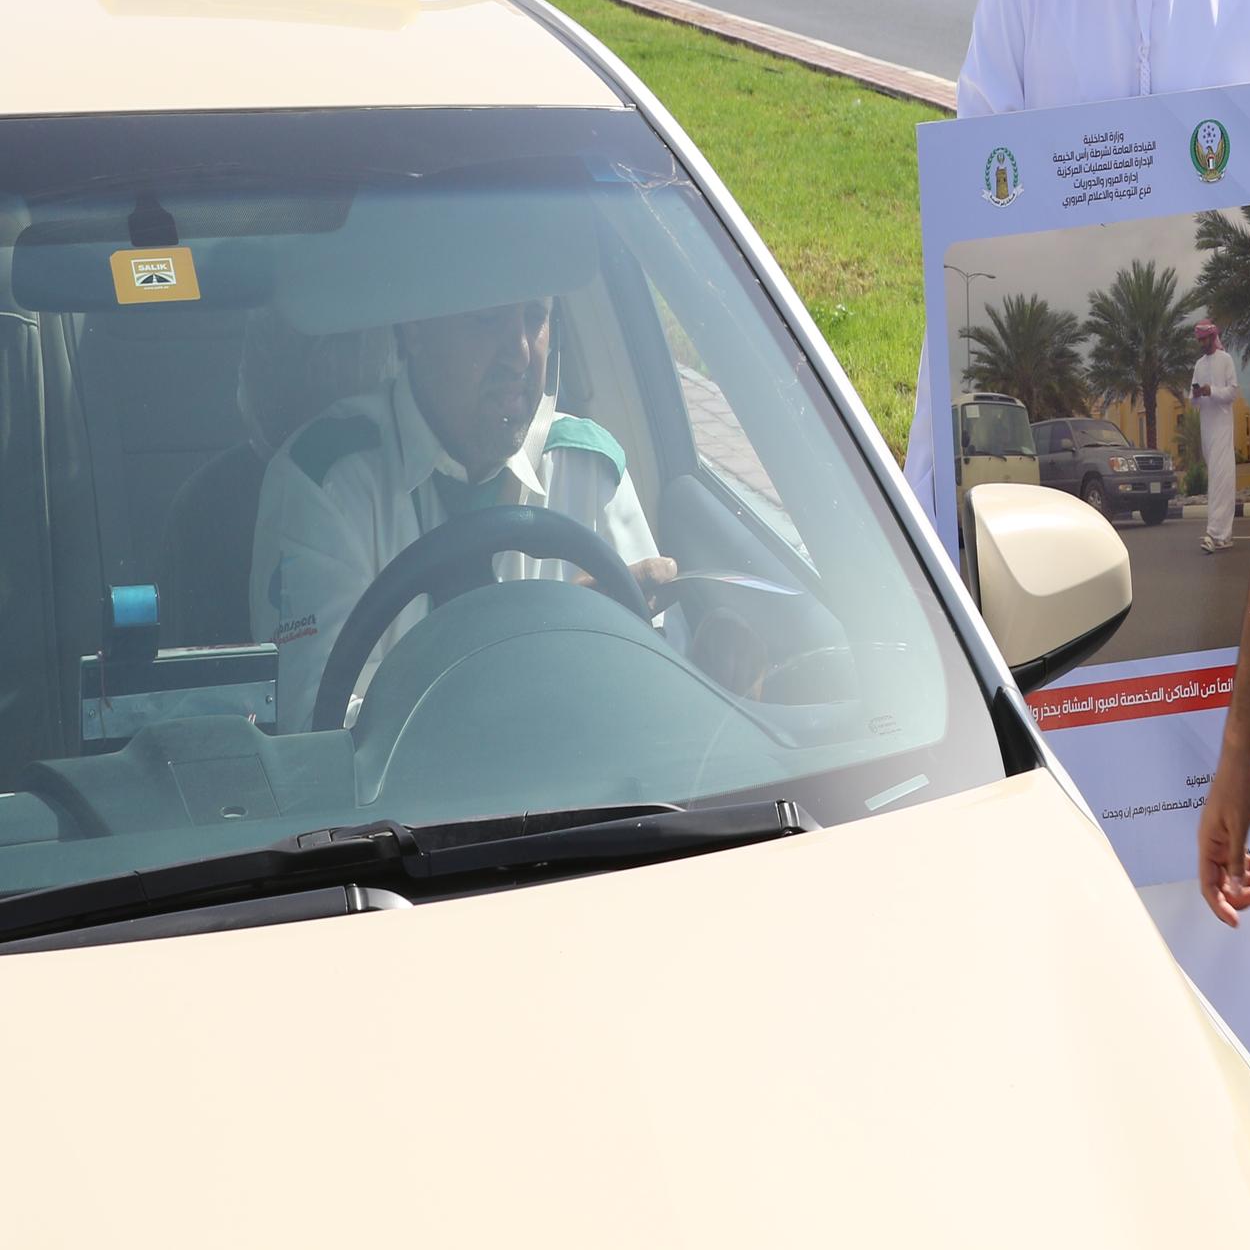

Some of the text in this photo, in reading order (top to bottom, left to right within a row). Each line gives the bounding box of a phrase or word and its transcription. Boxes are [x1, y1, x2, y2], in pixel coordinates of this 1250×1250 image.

[1083, 130, 1125, 146] وزارة الداخلية
[1052, 141, 1157, 165] القيادة العامة لشرطة رأس الخيمة
[1083, 160, 1113, 175] للعمليات
[1113, 158, 1134, 169] العامة
[1056, 165, 1083, 179] المركزية
[1073, 177, 1105, 191] والدوريات
[1104, 173, 1124, 188] المرور
[1114, 186, 1138, 200] التوعية
[1138, 185, 1152, 200] فرع
[1062, 193, 1087, 210] المروري
[137, 263, 169, 271] SALIK
[1120, 690, 1165, 706] المخصصة
[1166, 681, 1199, 702] الأماكن
[1200, 683, 1217, 698] من
[1062, 696, 1094, 714] المشاة
[1095, 693, 1120, 714] لعبور
[1040, 702, 1061, 721] بحذر
[1132, 802, 1161, 821] لعبورهم
[1161, 798, 1193, 811] المخصصة
[1101, 808, 1123, 821] وجدت
